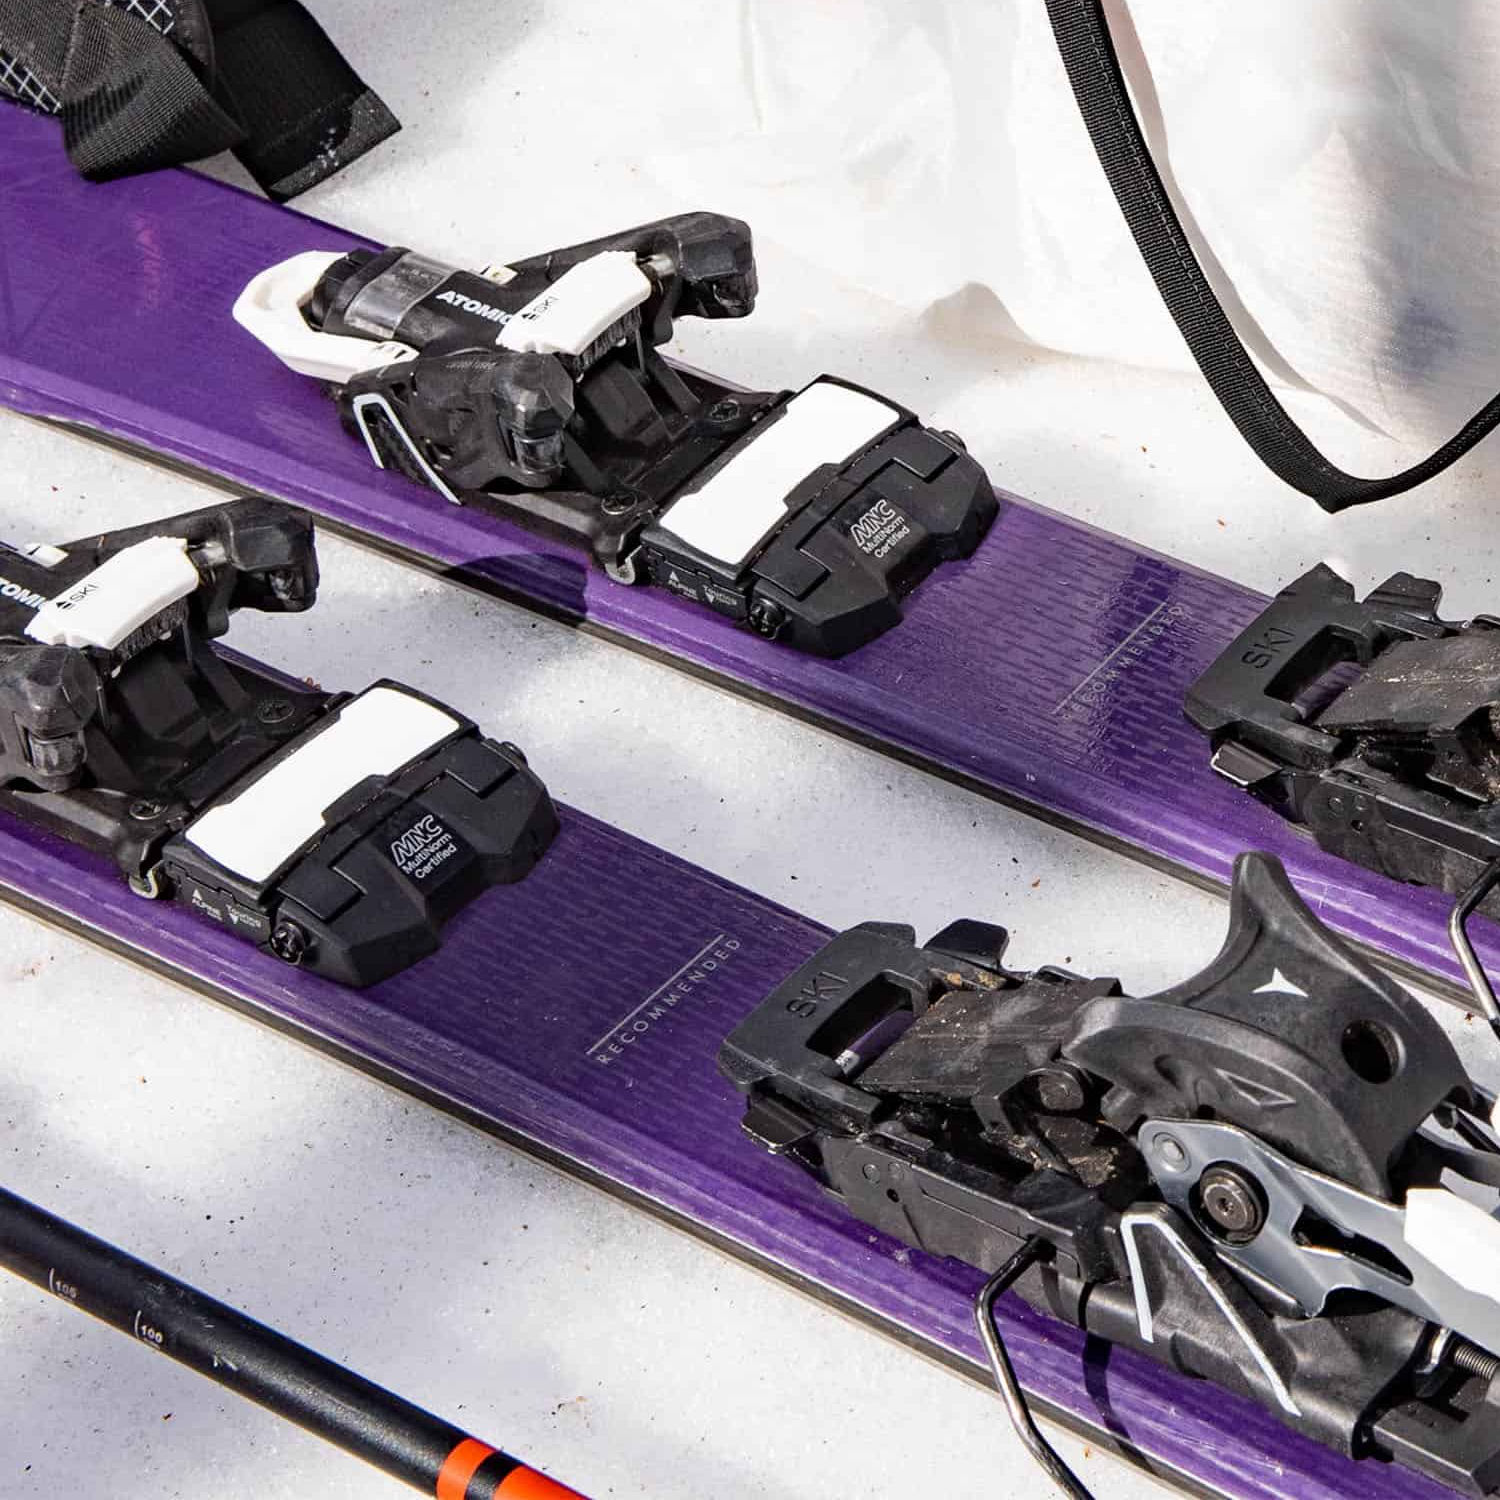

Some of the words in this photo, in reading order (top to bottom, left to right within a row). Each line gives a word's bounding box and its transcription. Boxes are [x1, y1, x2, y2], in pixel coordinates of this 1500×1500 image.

[849, 498, 897, 548] MNC
[861, 515, 905, 555] MultiNorm
[873, 524, 911, 559] Certified
[69, 583, 100, 602] SKI
[1061, 605, 1185, 723] RECOMMENDED
[1241, 627, 1296, 669] SKI
[390, 814, 444, 867] MNC
[401, 832, 453, 875] MultiNorm
[414, 842, 457, 879] Certified
[596, 938, 741, 1065] RECOMMENDED
[785, 970, 849, 1019] SKI
[140, 1323, 164, 1345] 100
